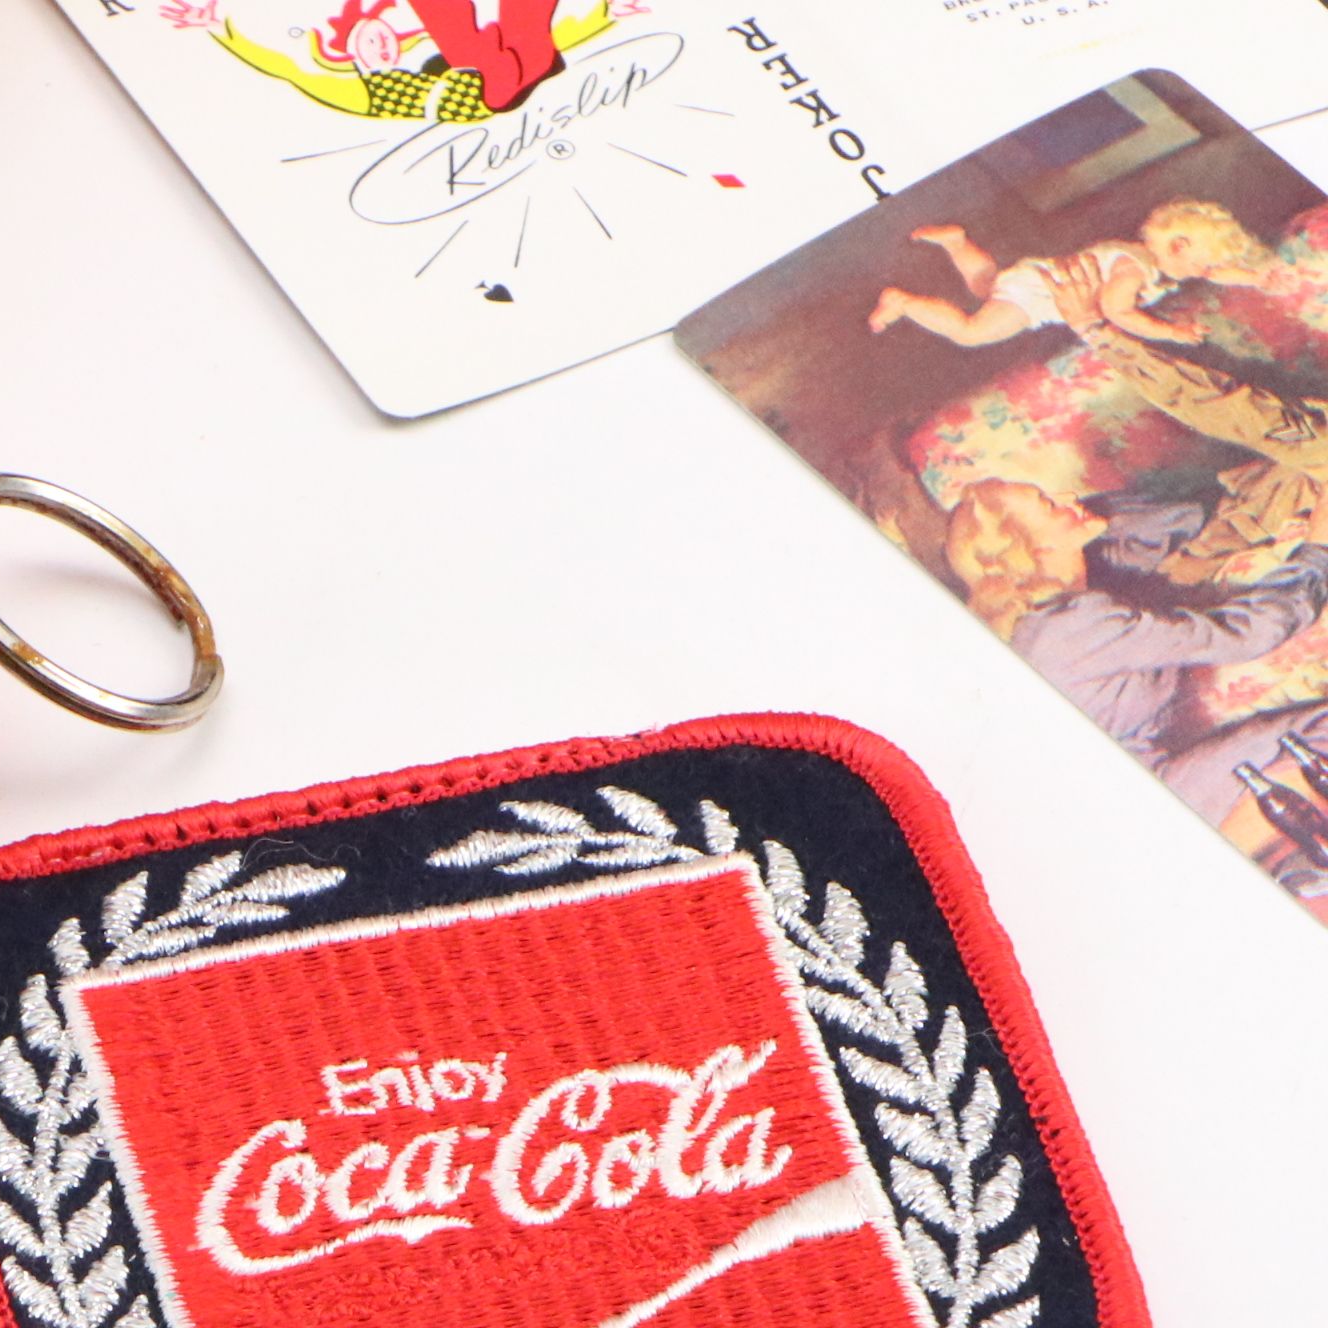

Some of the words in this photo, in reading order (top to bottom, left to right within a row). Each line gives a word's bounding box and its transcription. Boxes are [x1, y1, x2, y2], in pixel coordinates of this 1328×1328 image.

[726, 17, 892, 201] JOKER
[195, 1039, 793, 1274] Coca-Cola
[319, 1051, 508, 1117] Enjoy
